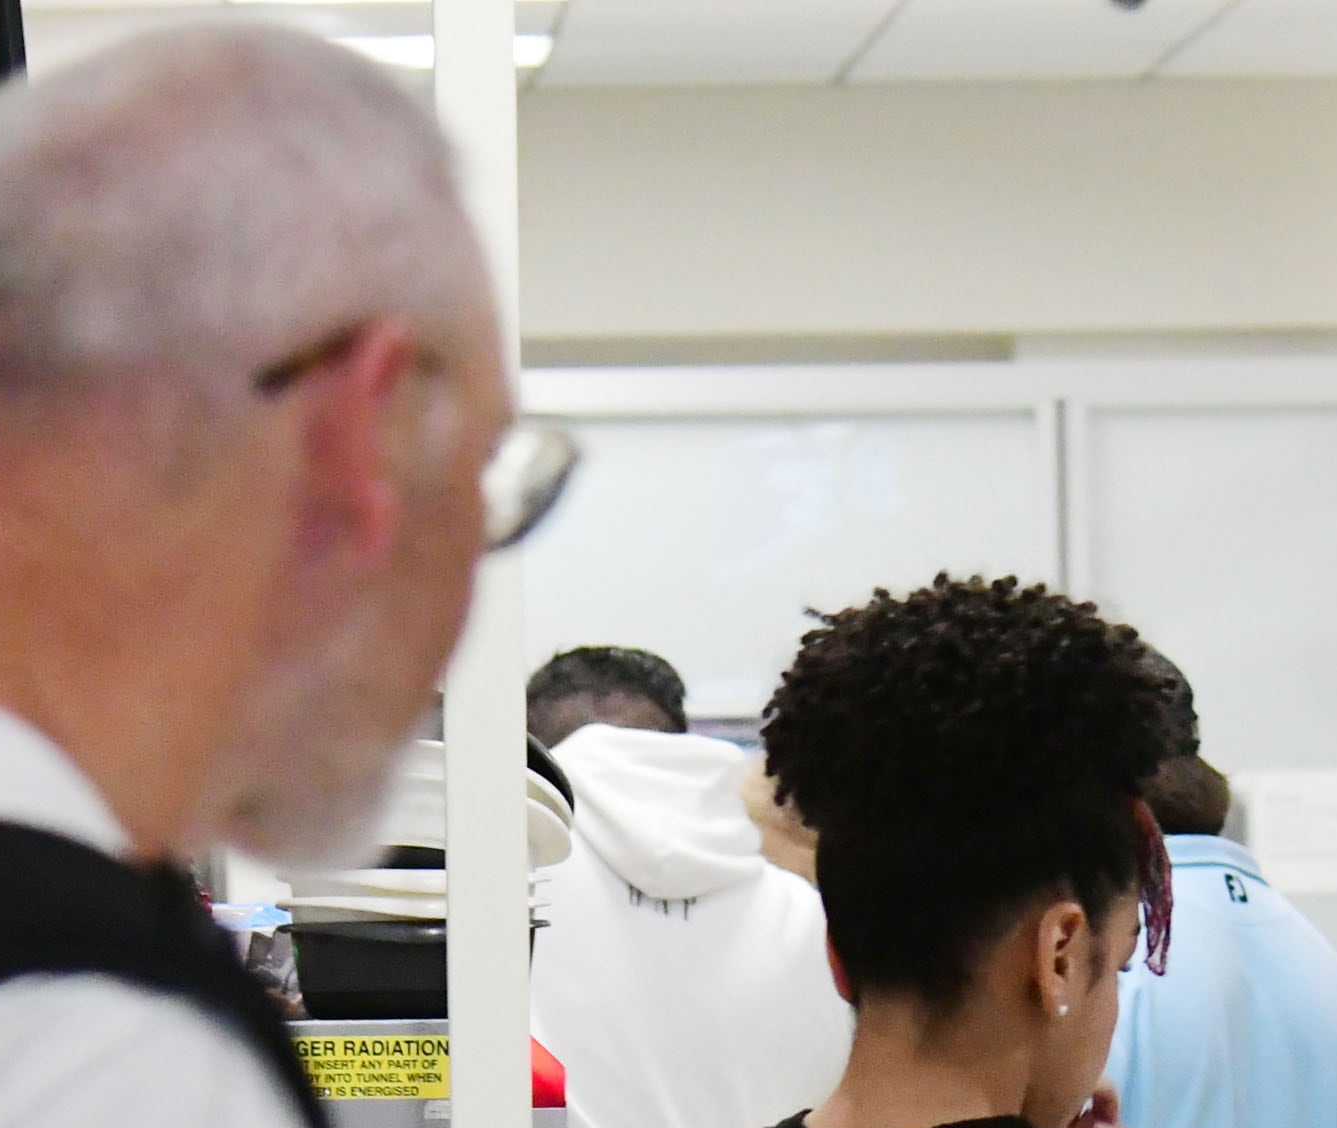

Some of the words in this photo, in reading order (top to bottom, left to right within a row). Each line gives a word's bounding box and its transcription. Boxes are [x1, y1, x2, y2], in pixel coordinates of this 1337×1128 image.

[344, 1040, 449, 1057] RADIATION
[315, 1060, 355, 1070] INSERT
[360, 1060, 384, 1070] ANY
[388, 1060, 418, 1070] PART
[422, 1059, 438, 1069] OF
[325, 1073, 352, 1084] INTO
[357, 1073, 402, 1083] TUNNEL
[407, 1073, 442, 1083] WHEN
[336, 1087, 346, 1096] IS
[351, 1086, 419, 1096] ENERGISED
